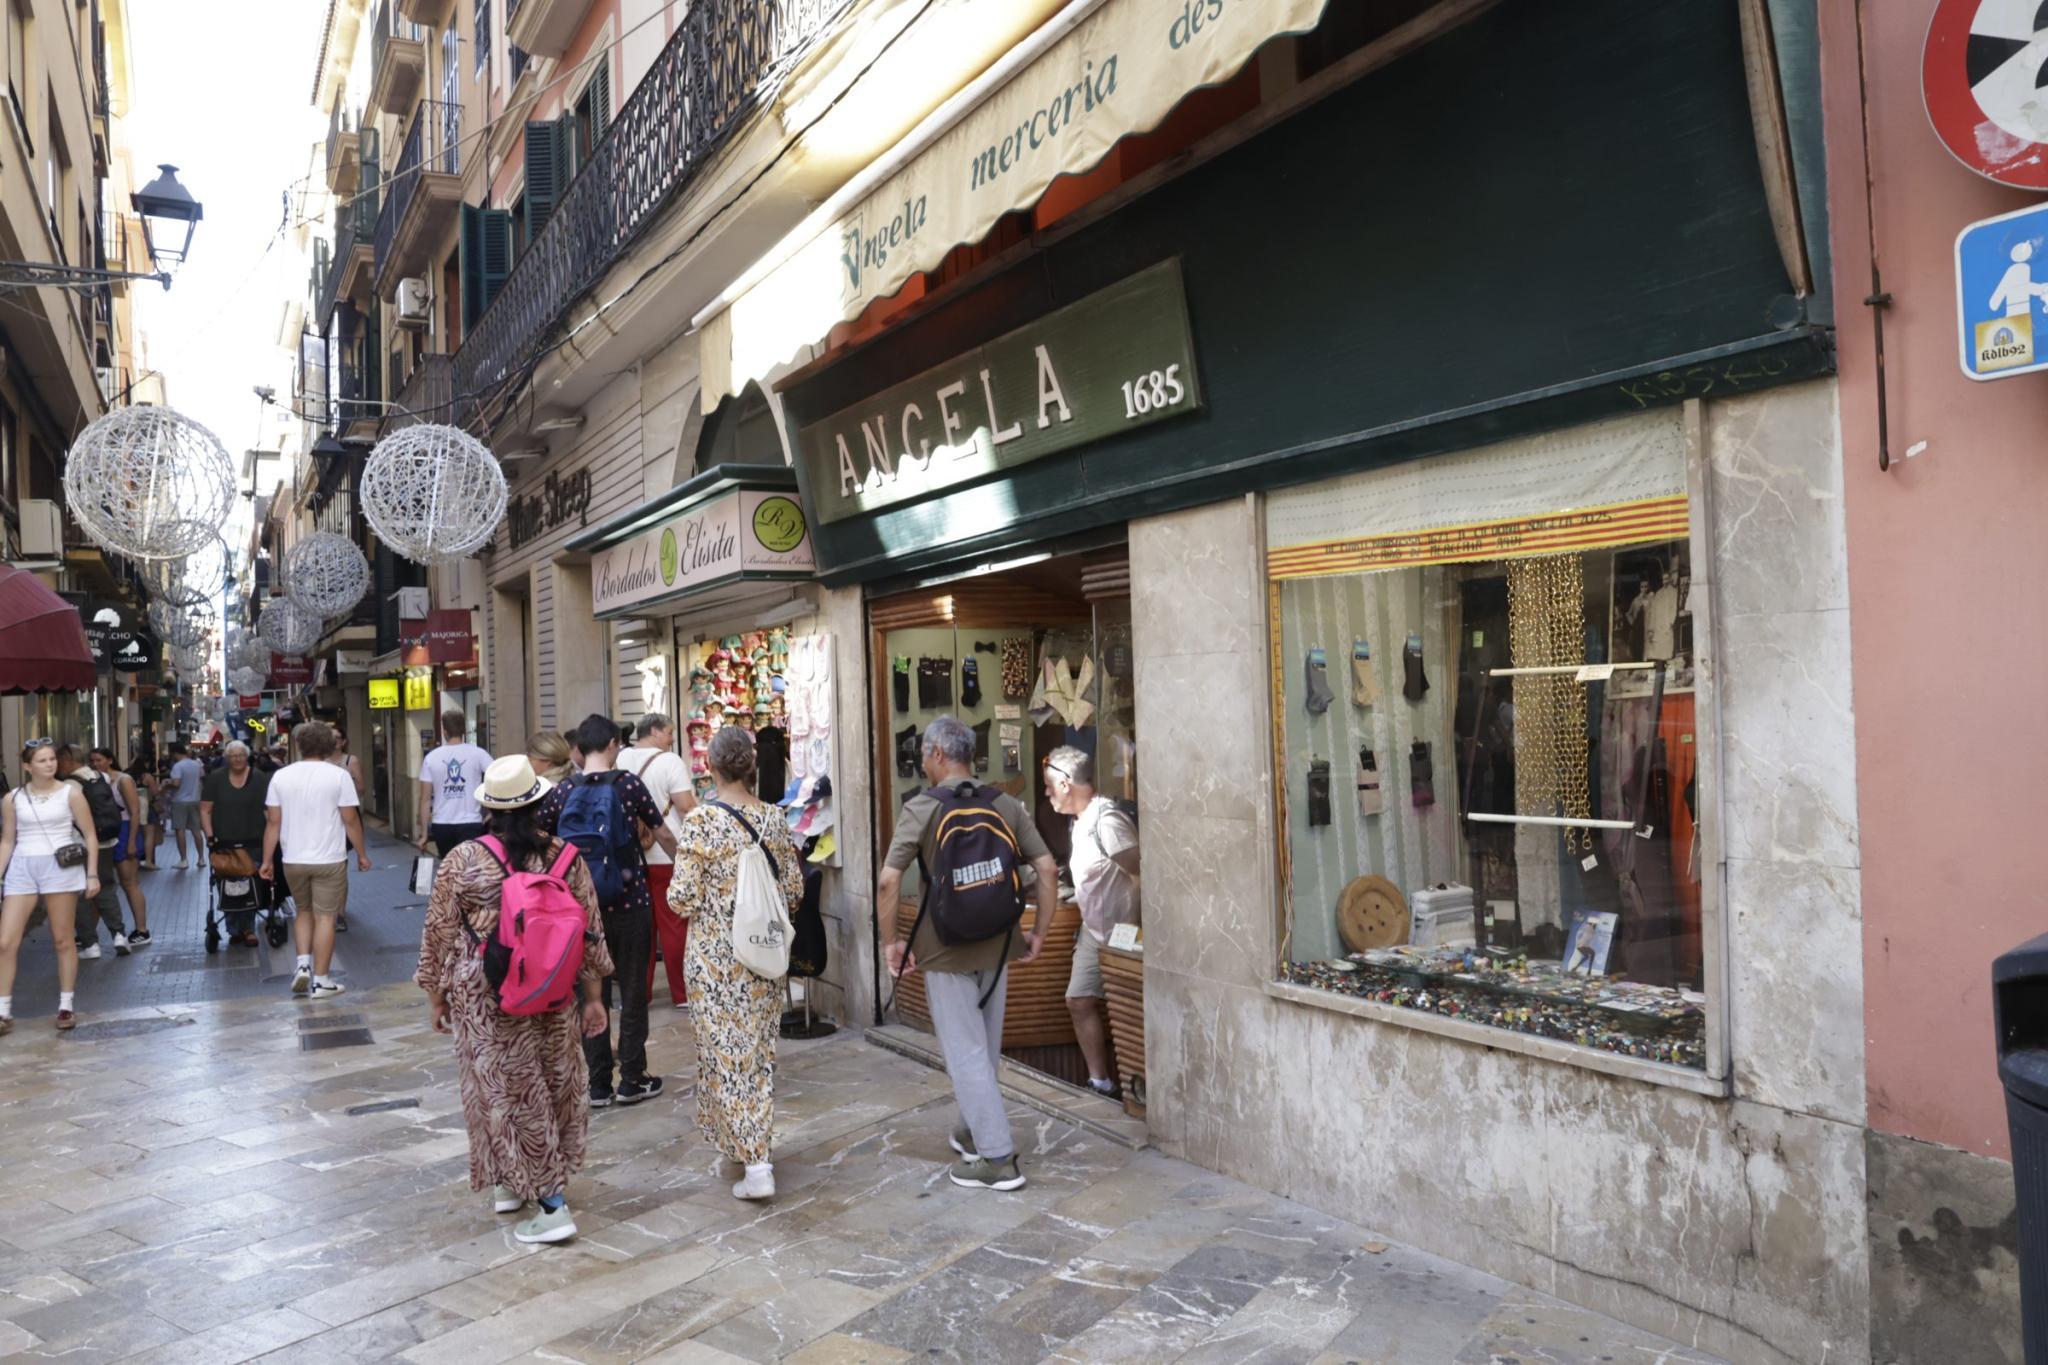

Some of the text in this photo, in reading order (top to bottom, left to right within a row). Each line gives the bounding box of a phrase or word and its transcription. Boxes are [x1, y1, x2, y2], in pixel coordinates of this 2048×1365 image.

[971, 53, 1118, 191] merceria
[834, 344, 1185, 498] ANGELA 1685
[544, 466, 592, 529] Sheep
[595, 540, 657, 604] Bordados
[680, 515, 736, 577] Elisita
[431, 631, 469, 639] MAJORICA
[952, 857, 1003, 887] PUMA
